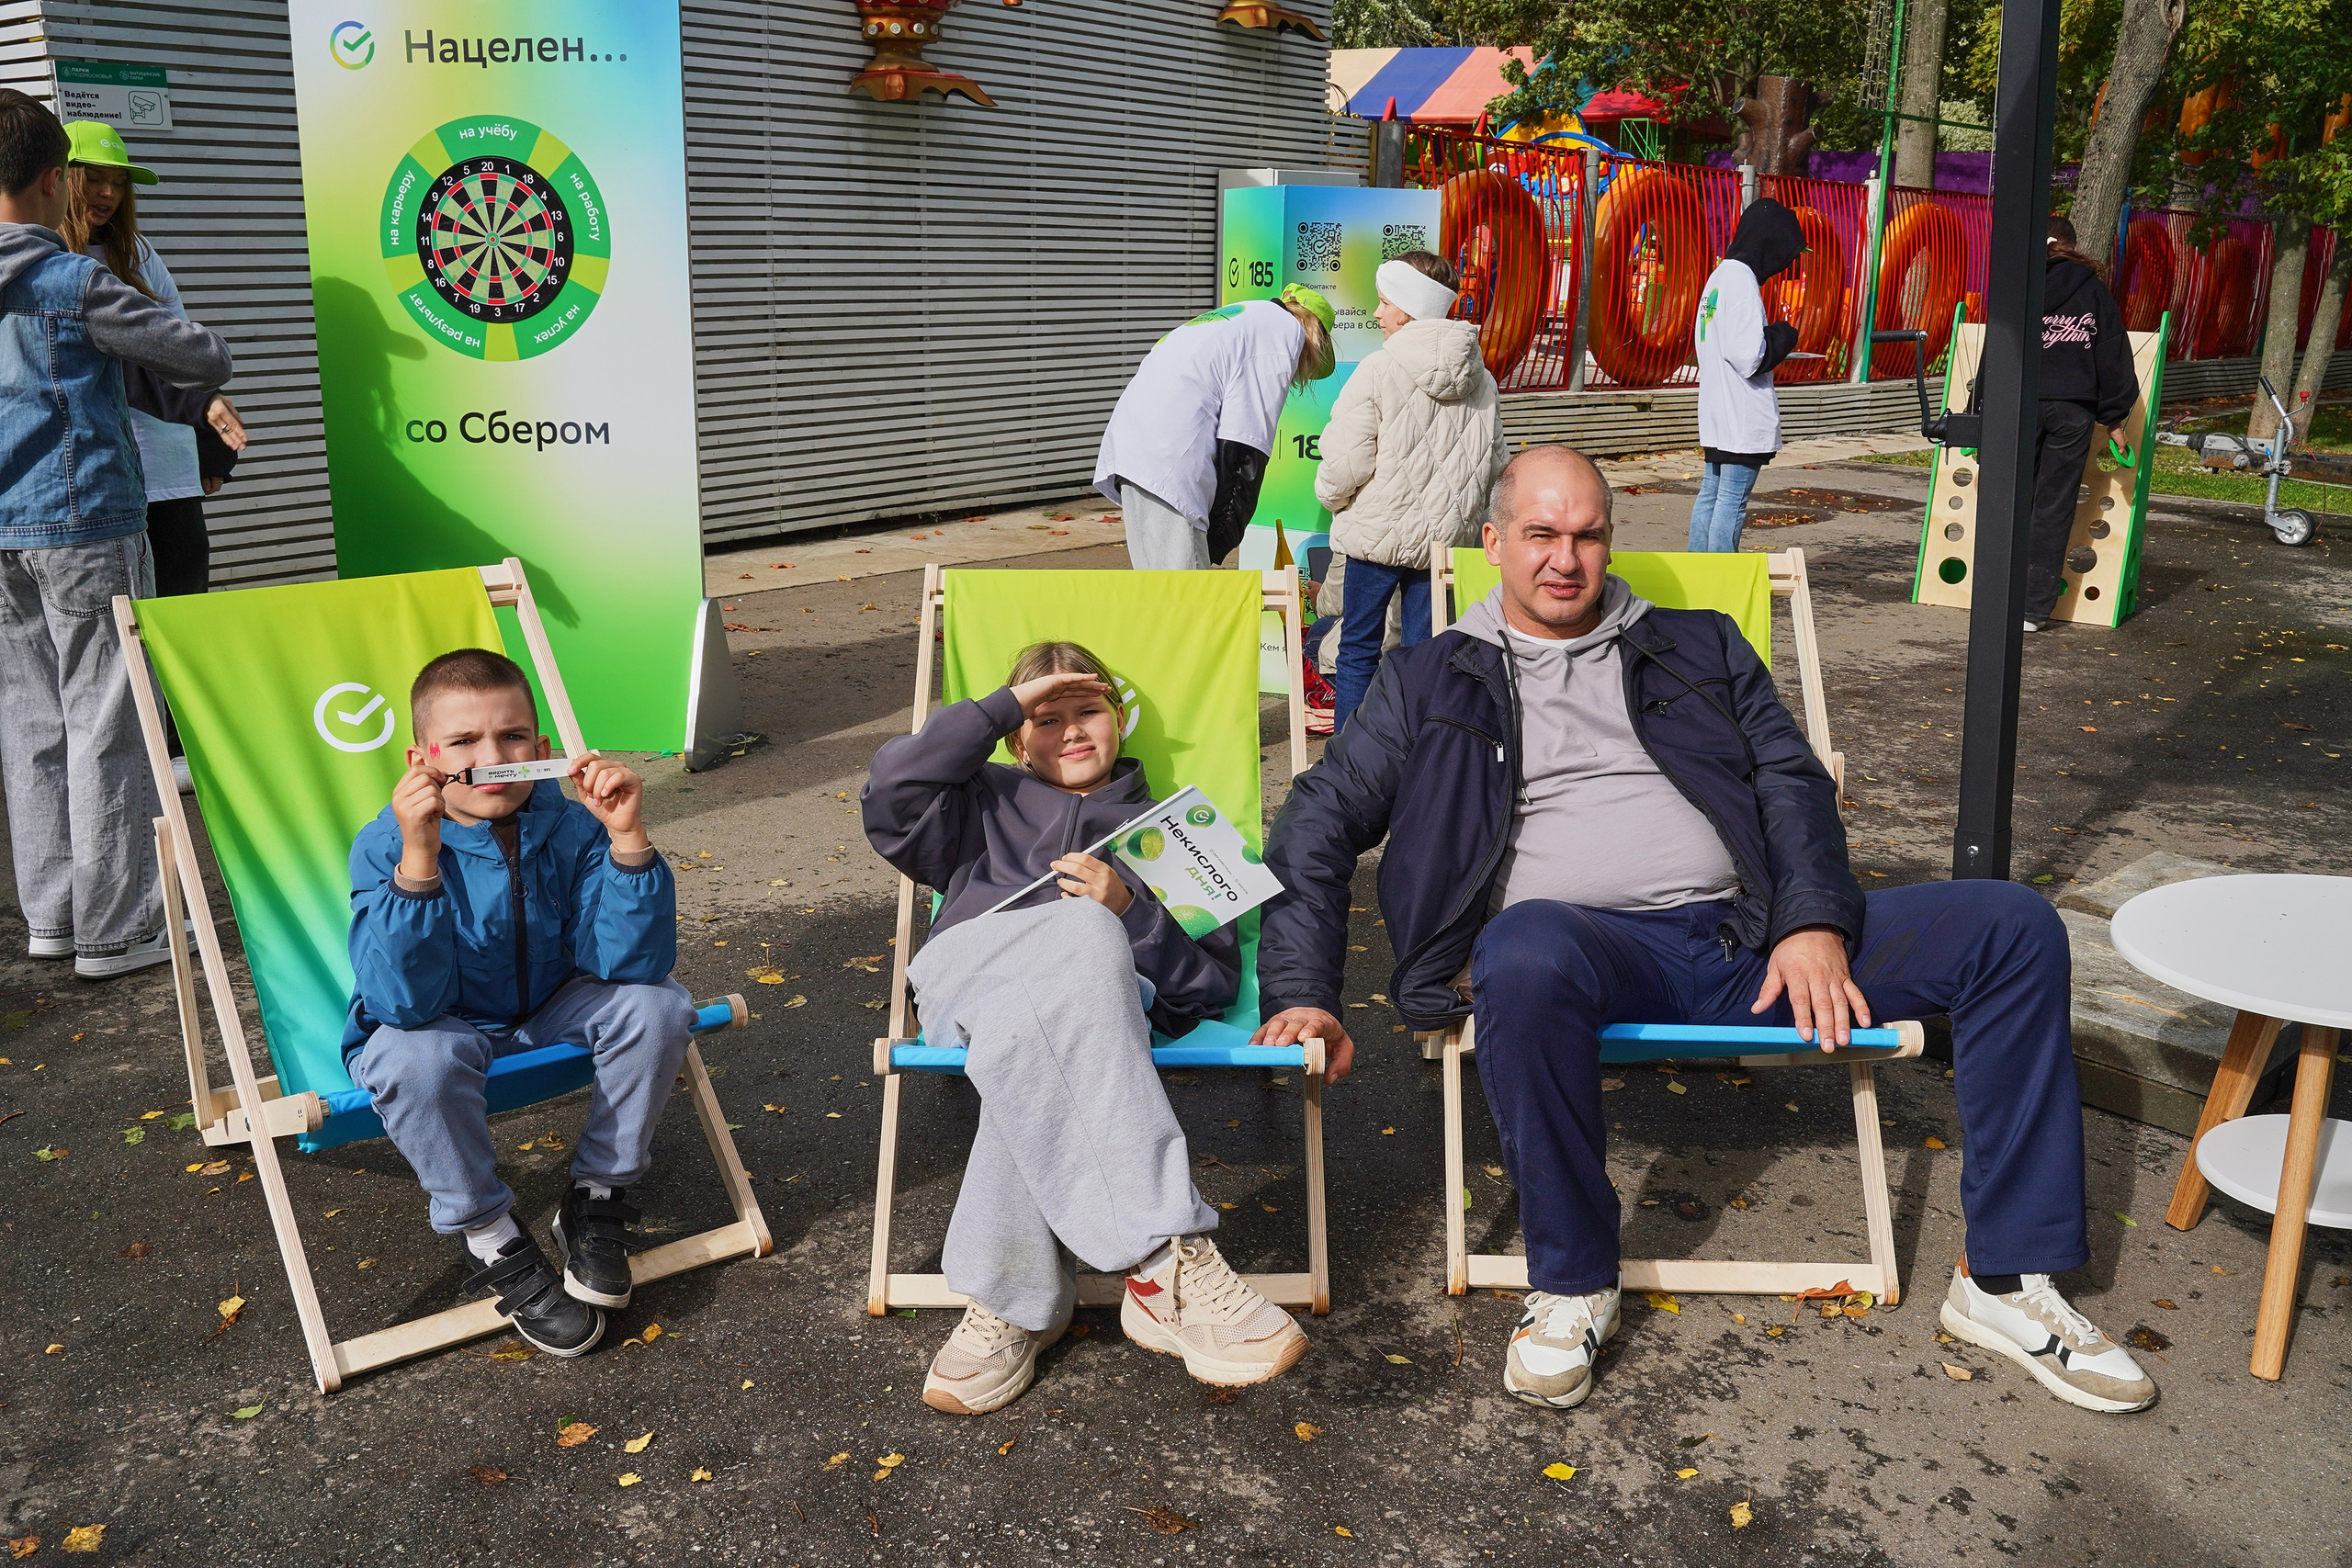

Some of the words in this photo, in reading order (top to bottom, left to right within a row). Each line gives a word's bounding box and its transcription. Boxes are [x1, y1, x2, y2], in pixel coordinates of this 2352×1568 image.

[404, 29, 628, 68] Нацелен...
[64, 90, 100, 99] Ведётся
[67, 111, 122, 119] наблюдение!
[458, 127, 476, 140] на
[479, 123, 518, 141] учёбу
[463, 165, 470, 175] 5
[481, 161, 494, 171] 20
[504, 165, 510, 174] 1
[441, 176, 454, 186] 12
[522, 174, 534, 184] 18
[390, 169, 416, 226] карьеру
[432, 192, 439, 201] 9
[540, 191, 548, 200] 4
[570, 173, 584, 190] на
[578, 190, 601, 242] работу
[421, 213, 433, 222] 14
[551, 210, 562, 220] 13
[390, 230, 400, 245] на
[420, 236, 430, 246] 11
[557, 232, 564, 242] 6
[427, 259, 435, 269] 8
[553, 257, 565, 266] 10
[1249, 261, 1273, 288] 185
[435, 277, 447, 288] 16
[546, 276, 557, 285] 15
[453, 293, 460, 303] 7
[533, 293, 540, 302] 2
[469, 304, 481, 313] 19
[494, 308, 502, 317] 3
[514, 303, 526, 313] 17
[565, 303, 581, 320] на
[1333, 306, 1367, 316] ывайся
[409, 292, 464, 342] результат
[533, 316, 568, 344] успех
[1333, 321, 1355, 331] ьера
[1365, 320, 1382, 330] Сбе
[465, 335, 481, 348] на
[2041, 325, 2092, 349] rything
[405, 419, 448, 443] со
[459, 410, 610, 452] Сбером
[1292, 434, 1324, 461] 18
[1260, 642, 1280, 651] Кем
[1159, 815, 1238, 902] Некислого
[1183, 866, 1222, 901] дня!
